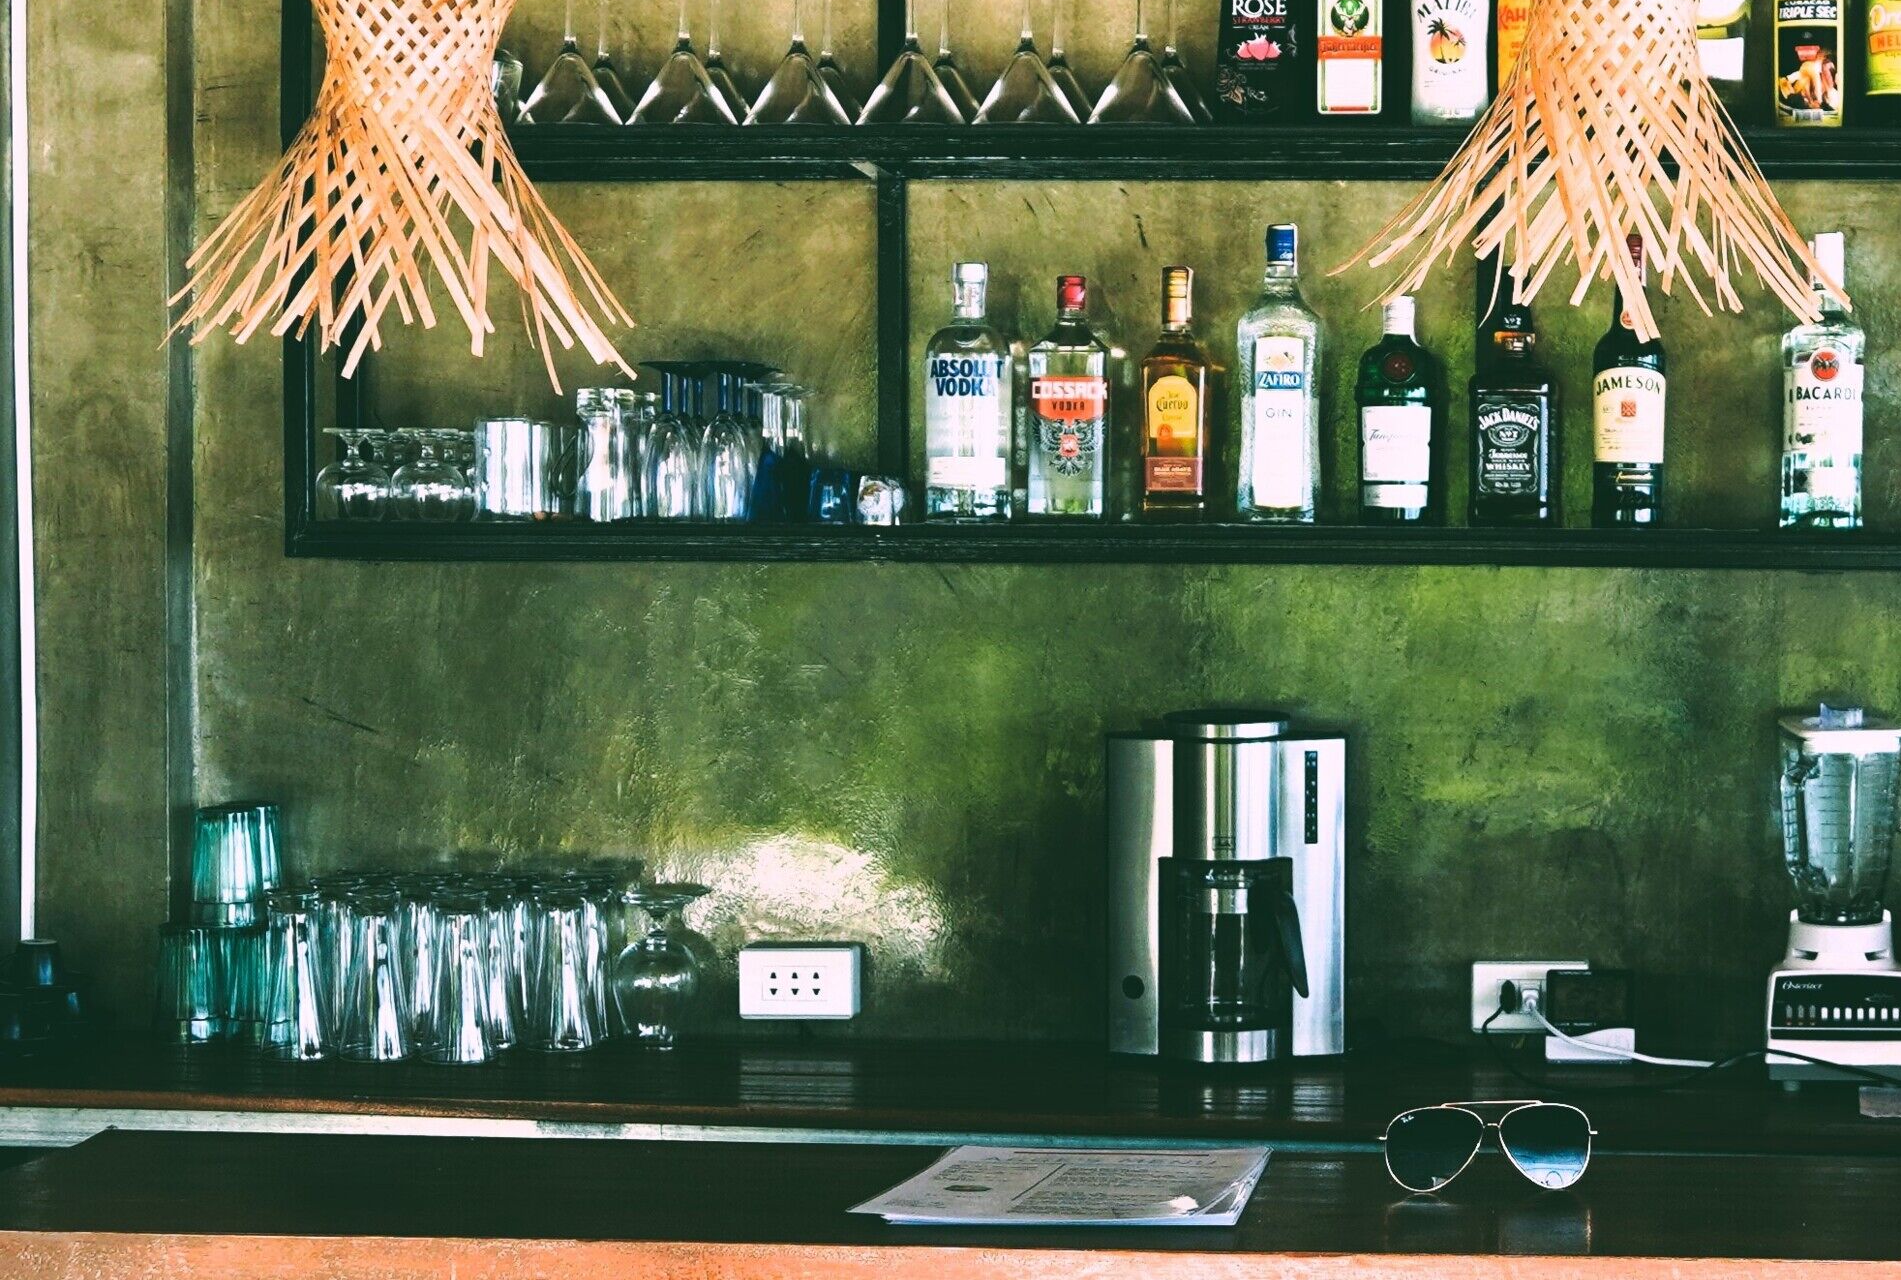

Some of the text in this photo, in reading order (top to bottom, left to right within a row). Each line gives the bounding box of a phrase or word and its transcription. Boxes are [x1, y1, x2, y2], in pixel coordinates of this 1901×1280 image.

[1779, 5, 1837, 19] TRIPLE SEC
[935, 377, 996, 397] VODKA
[1259, 372, 1301, 388] ZAFIRO
[1596, 375, 1661, 396] JAMESON
[1032, 381, 1108, 399] COSSACK
[1796, 386, 1856, 400] BACARDI
[1052, 401, 1085, 411] VODKA
[1156, 397, 1189, 412] Cuervo
[1479, 411, 1503, 430] JACK
